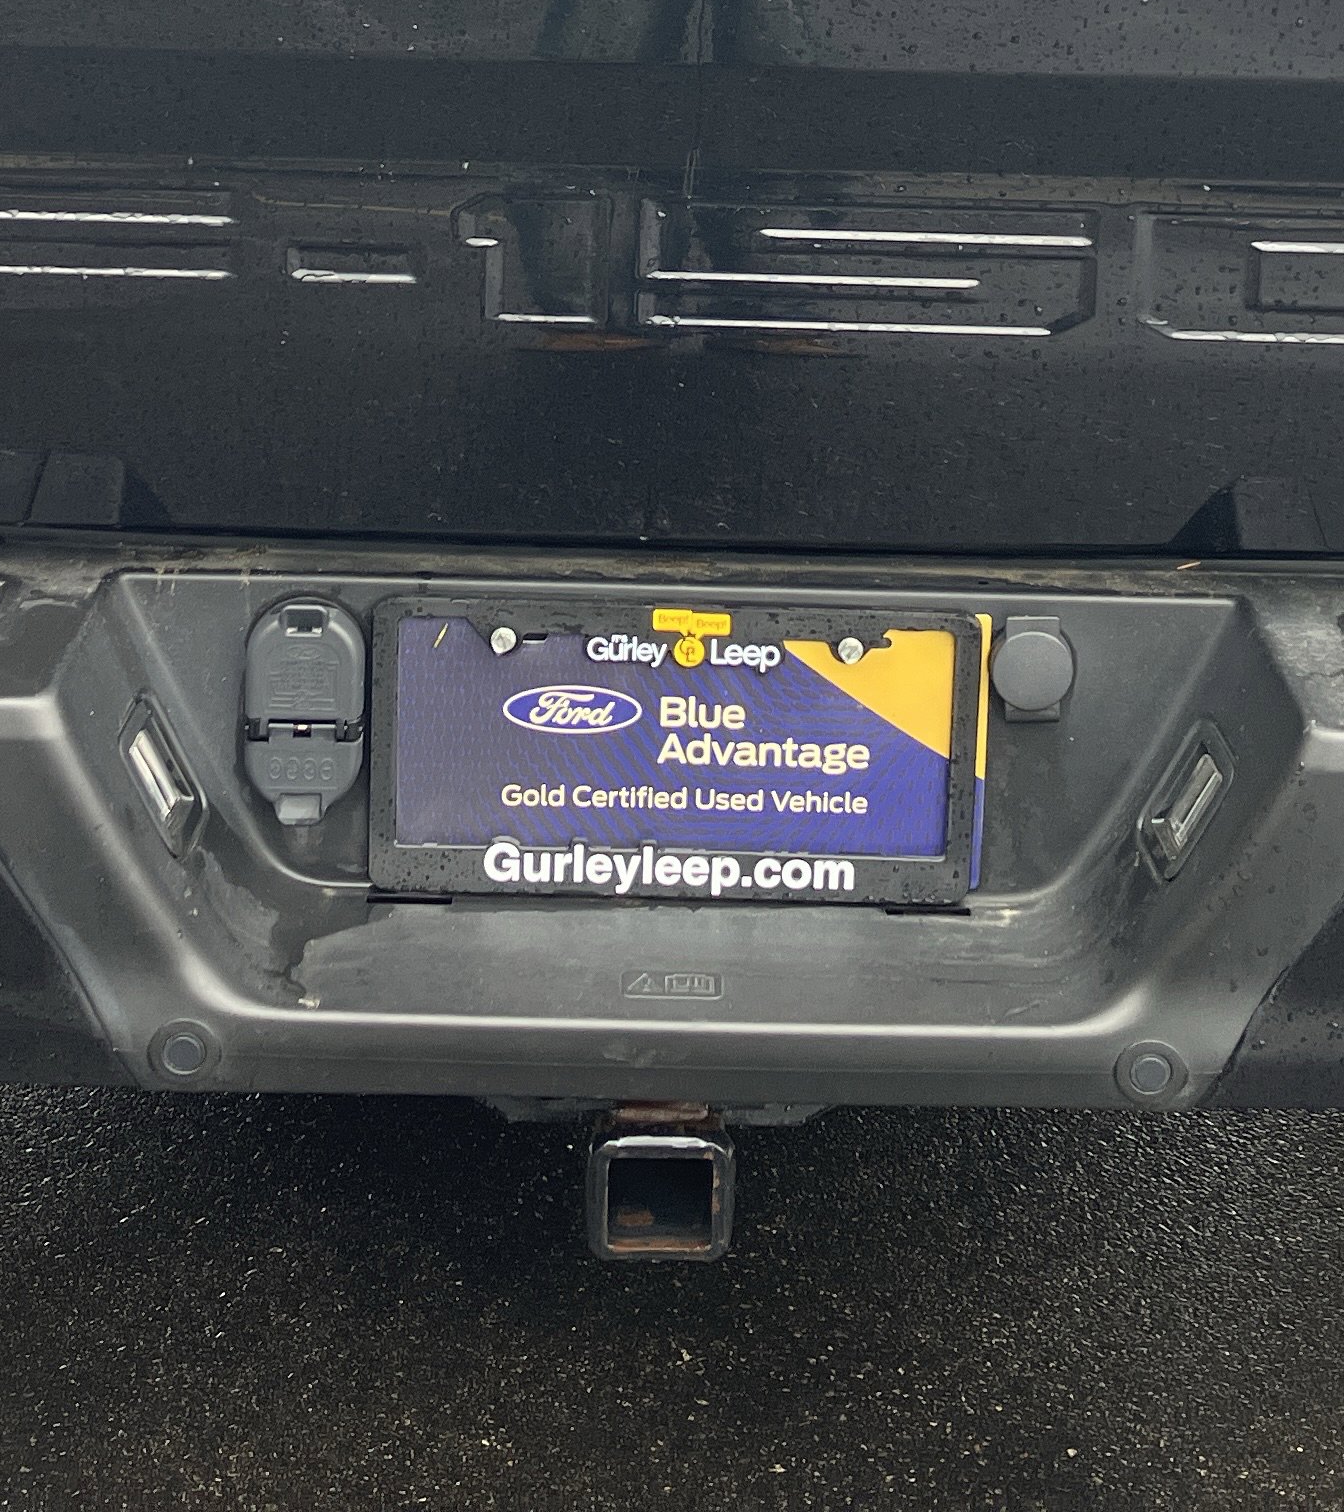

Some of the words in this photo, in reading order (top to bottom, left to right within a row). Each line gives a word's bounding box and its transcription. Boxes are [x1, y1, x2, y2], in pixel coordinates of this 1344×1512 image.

[710, 638, 781, 673] Leep
[528, 691, 616, 726] Ford
[659, 696, 745, 729] Blue
[657, 733, 870, 775] Advantage
[501, 784, 565, 807] Gold
[572, 786, 688, 809] Certified
[695, 788, 764, 811] Used
[771, 790, 869, 815] Vehicle
[483, 841, 855, 897] Gurleyleep.com
